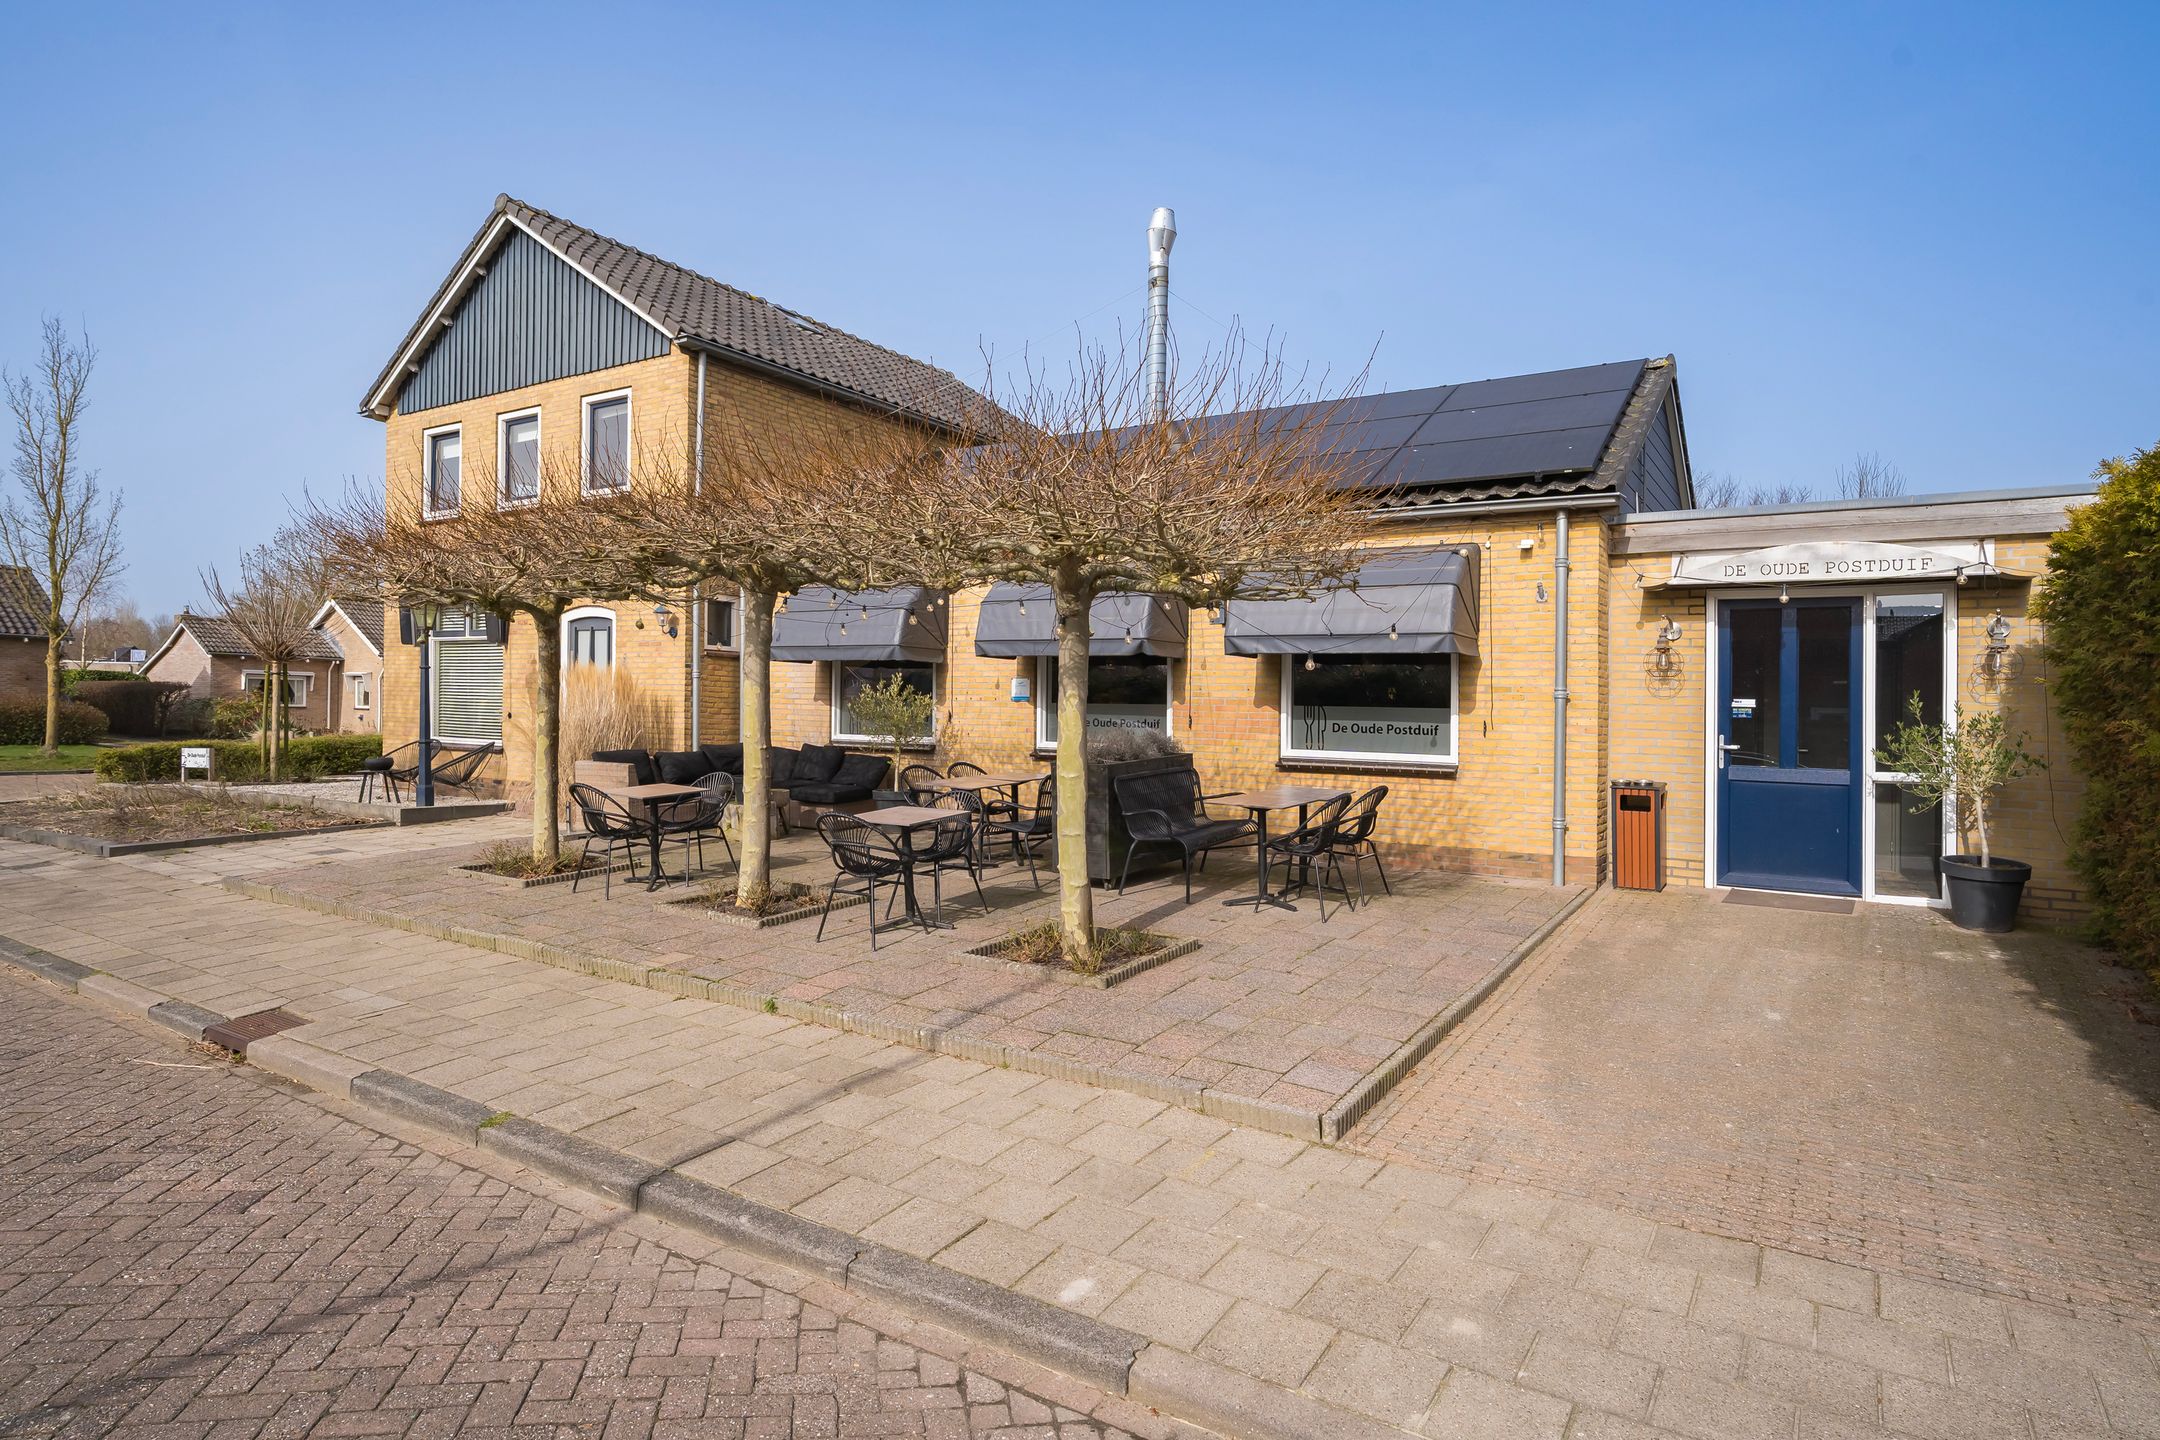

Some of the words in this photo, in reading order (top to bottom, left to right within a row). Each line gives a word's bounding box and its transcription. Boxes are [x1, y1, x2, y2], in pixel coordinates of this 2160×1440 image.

[1724, 564, 1747, 577] DE
[1760, 562, 1810, 576] OUDE
[1825, 557, 1933, 574] POSTDUIF
[1092, 718, 1118, 728] Oude
[1120, 718, 1161, 729] Postduif
[1332, 722, 1348, 733] De
[1351, 723, 1384, 734] Oude
[1386, 723, 1440, 736] Postduif
